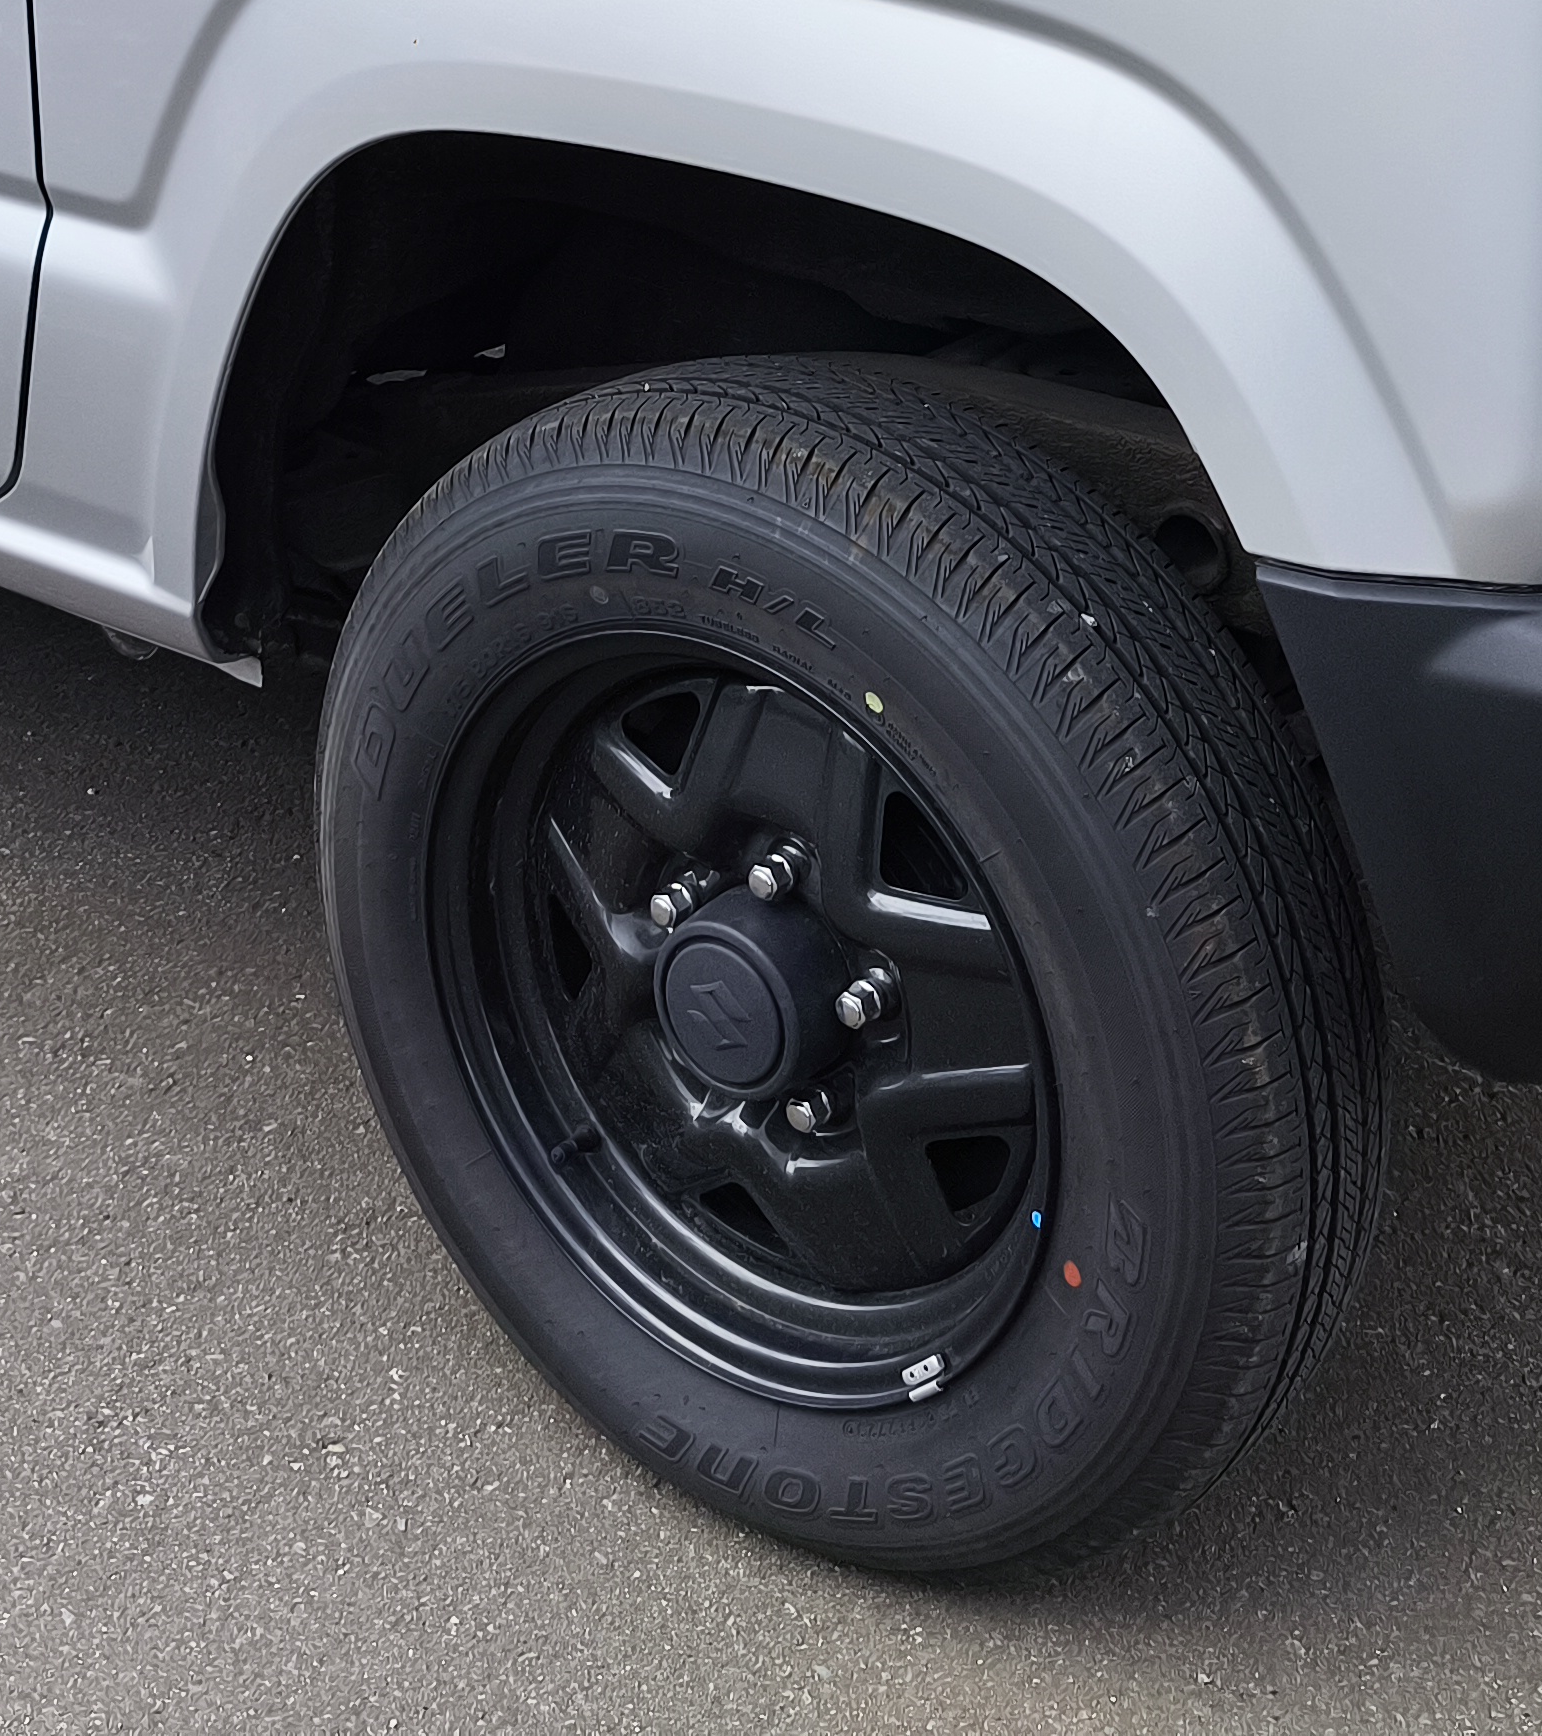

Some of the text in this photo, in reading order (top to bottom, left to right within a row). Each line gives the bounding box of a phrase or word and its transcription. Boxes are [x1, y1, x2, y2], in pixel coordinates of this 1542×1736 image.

[357, 529, 837, 802] DUELER H/L
[636, 1191, 1151, 1524] BRIDGESTONE
